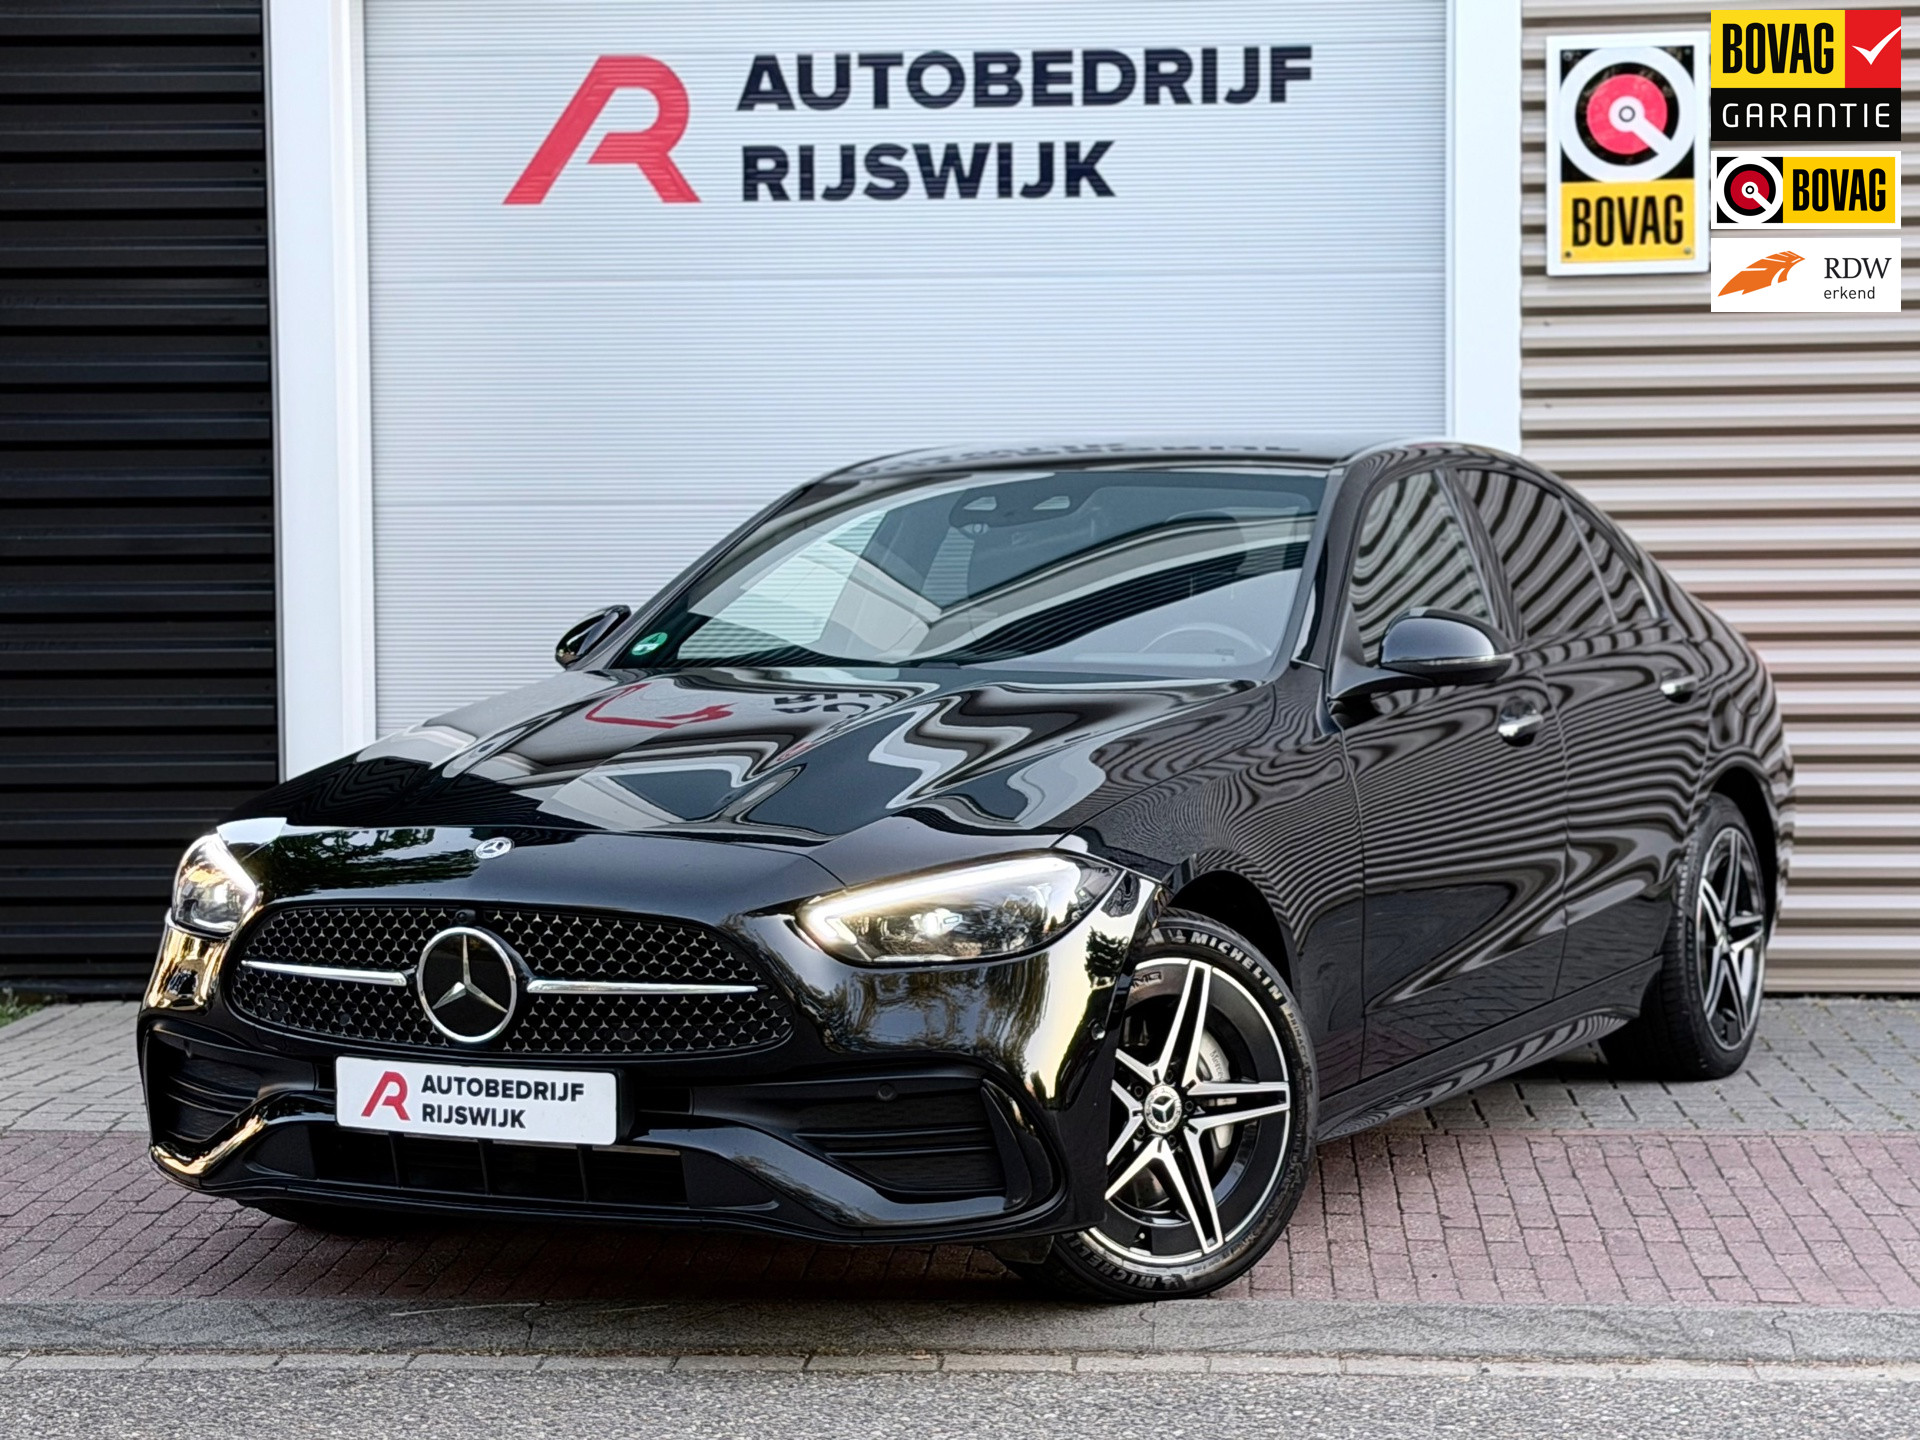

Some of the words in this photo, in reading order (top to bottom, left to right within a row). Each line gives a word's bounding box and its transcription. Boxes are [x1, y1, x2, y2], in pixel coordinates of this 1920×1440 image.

[738, 46, 1313, 111] AUTOBEDRIJF
[742, 140, 1116, 202] RIJSWIJK
[1572, 194, 1684, 247] BOVAG
[1190, 931, 1283, 1000] MICHELIN
[421, 1074, 585, 1102] AUTOBEDRIJF
[422, 1103, 527, 1129] RIJSWIJK
